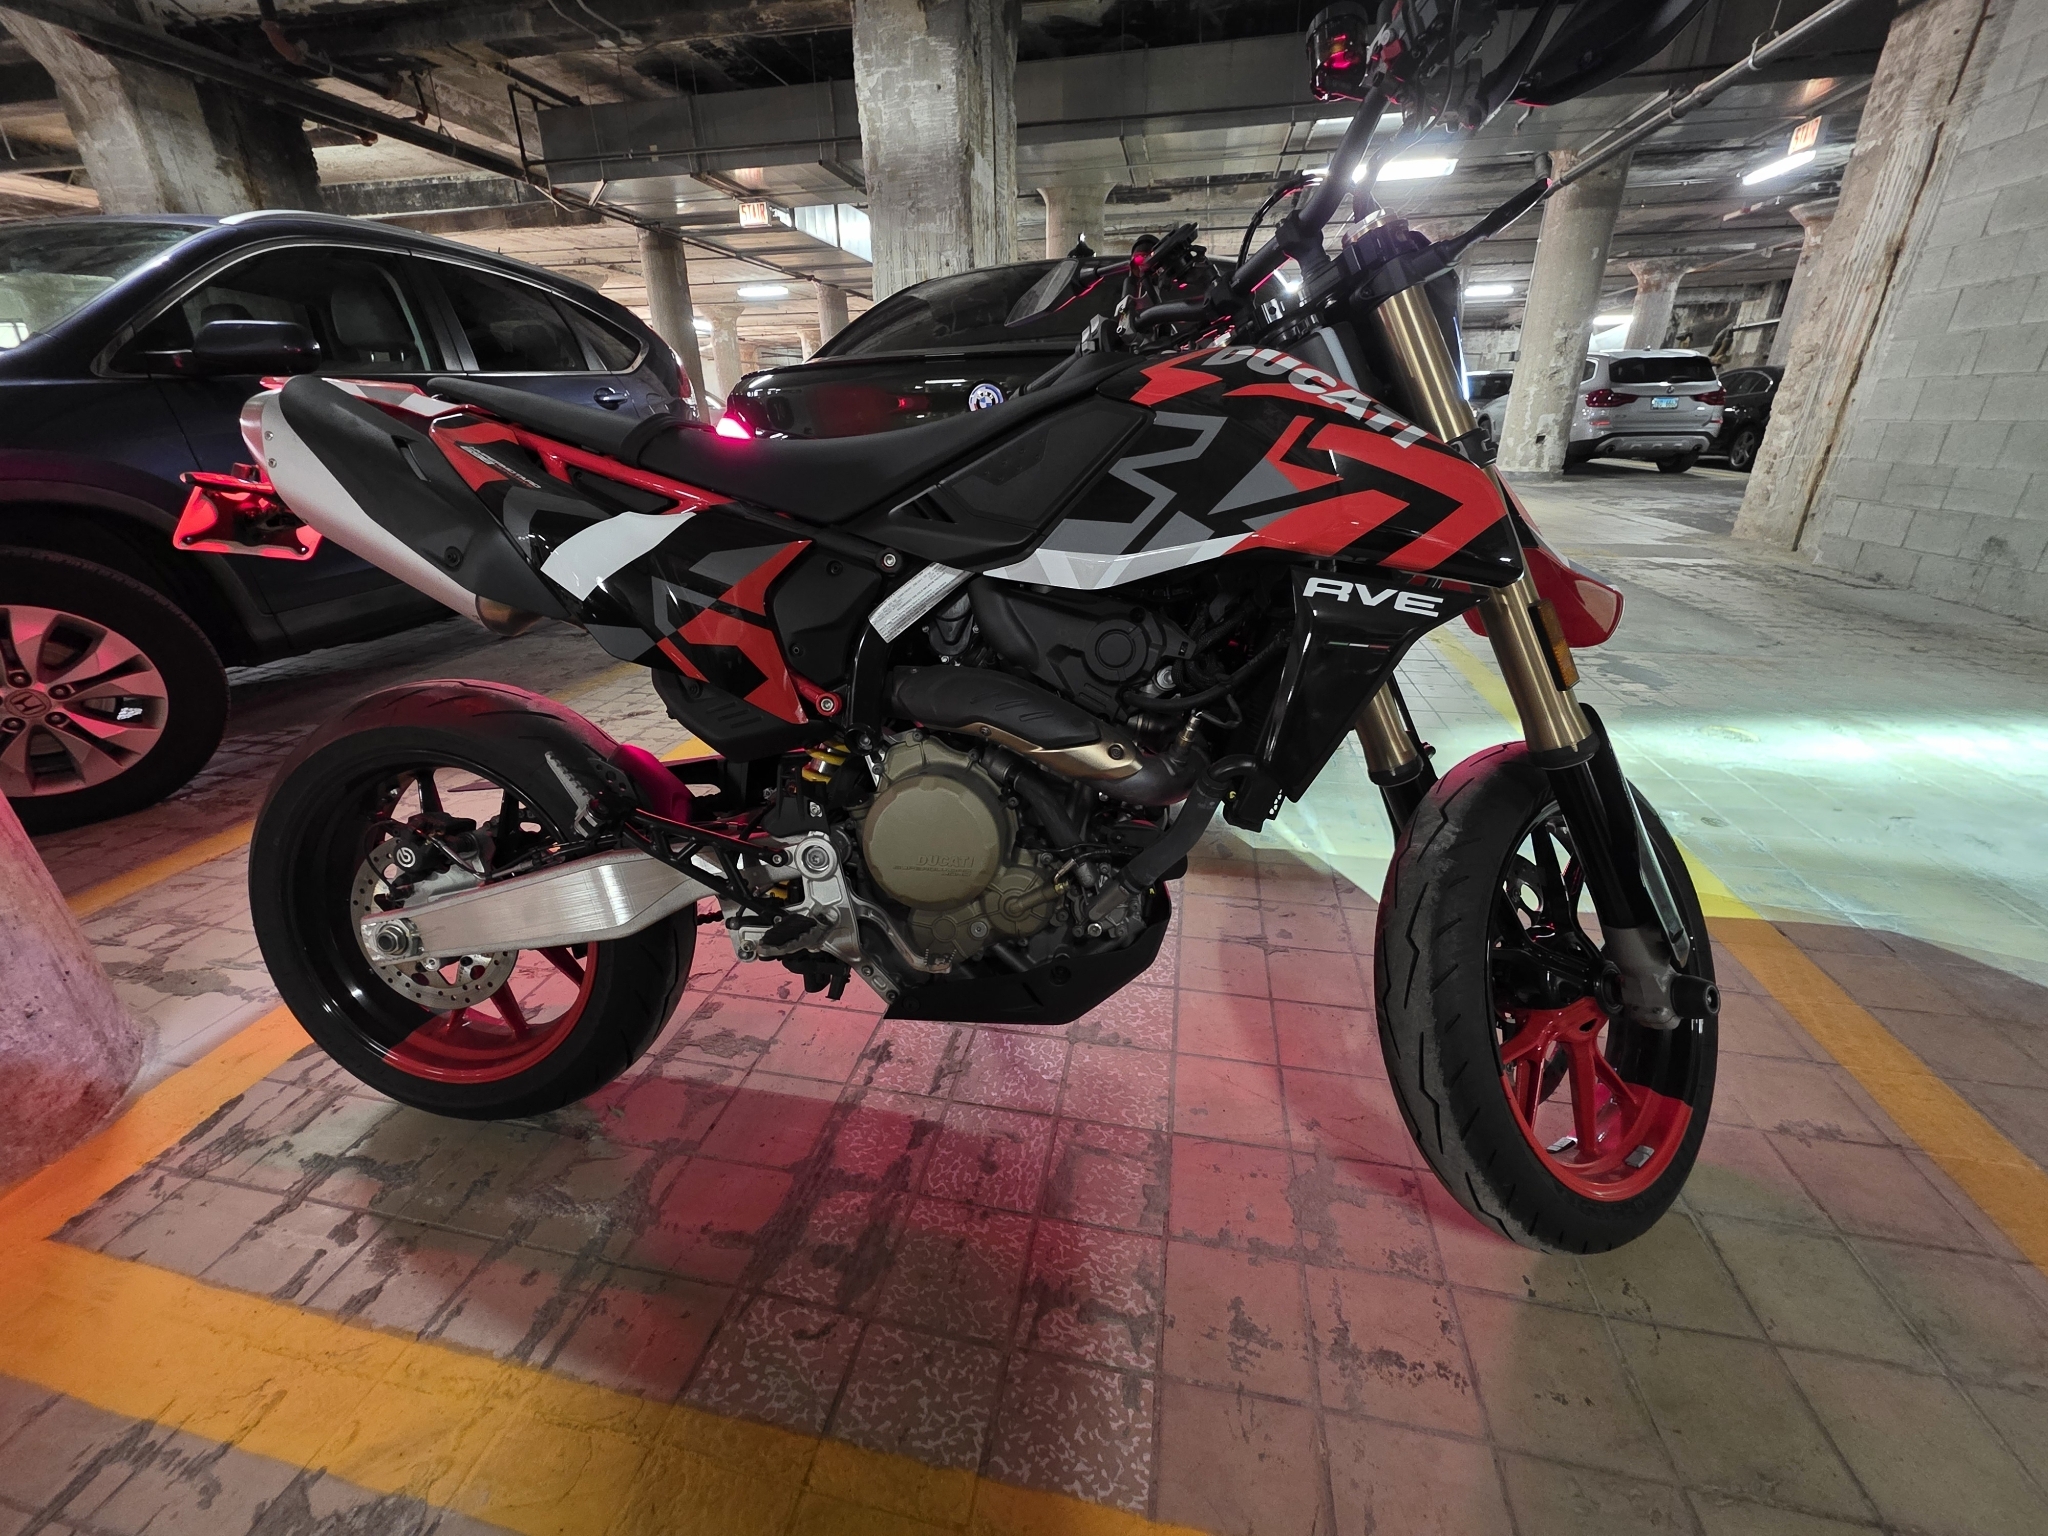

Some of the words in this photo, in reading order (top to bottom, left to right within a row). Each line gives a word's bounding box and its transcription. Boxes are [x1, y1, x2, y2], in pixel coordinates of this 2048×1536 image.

[741, 203, 767, 221] STAIR
[1201, 345, 1429, 449] DUCATI
[1302, 577, 1444, 618] RVE
[916, 854, 975, 868] DUCATI
